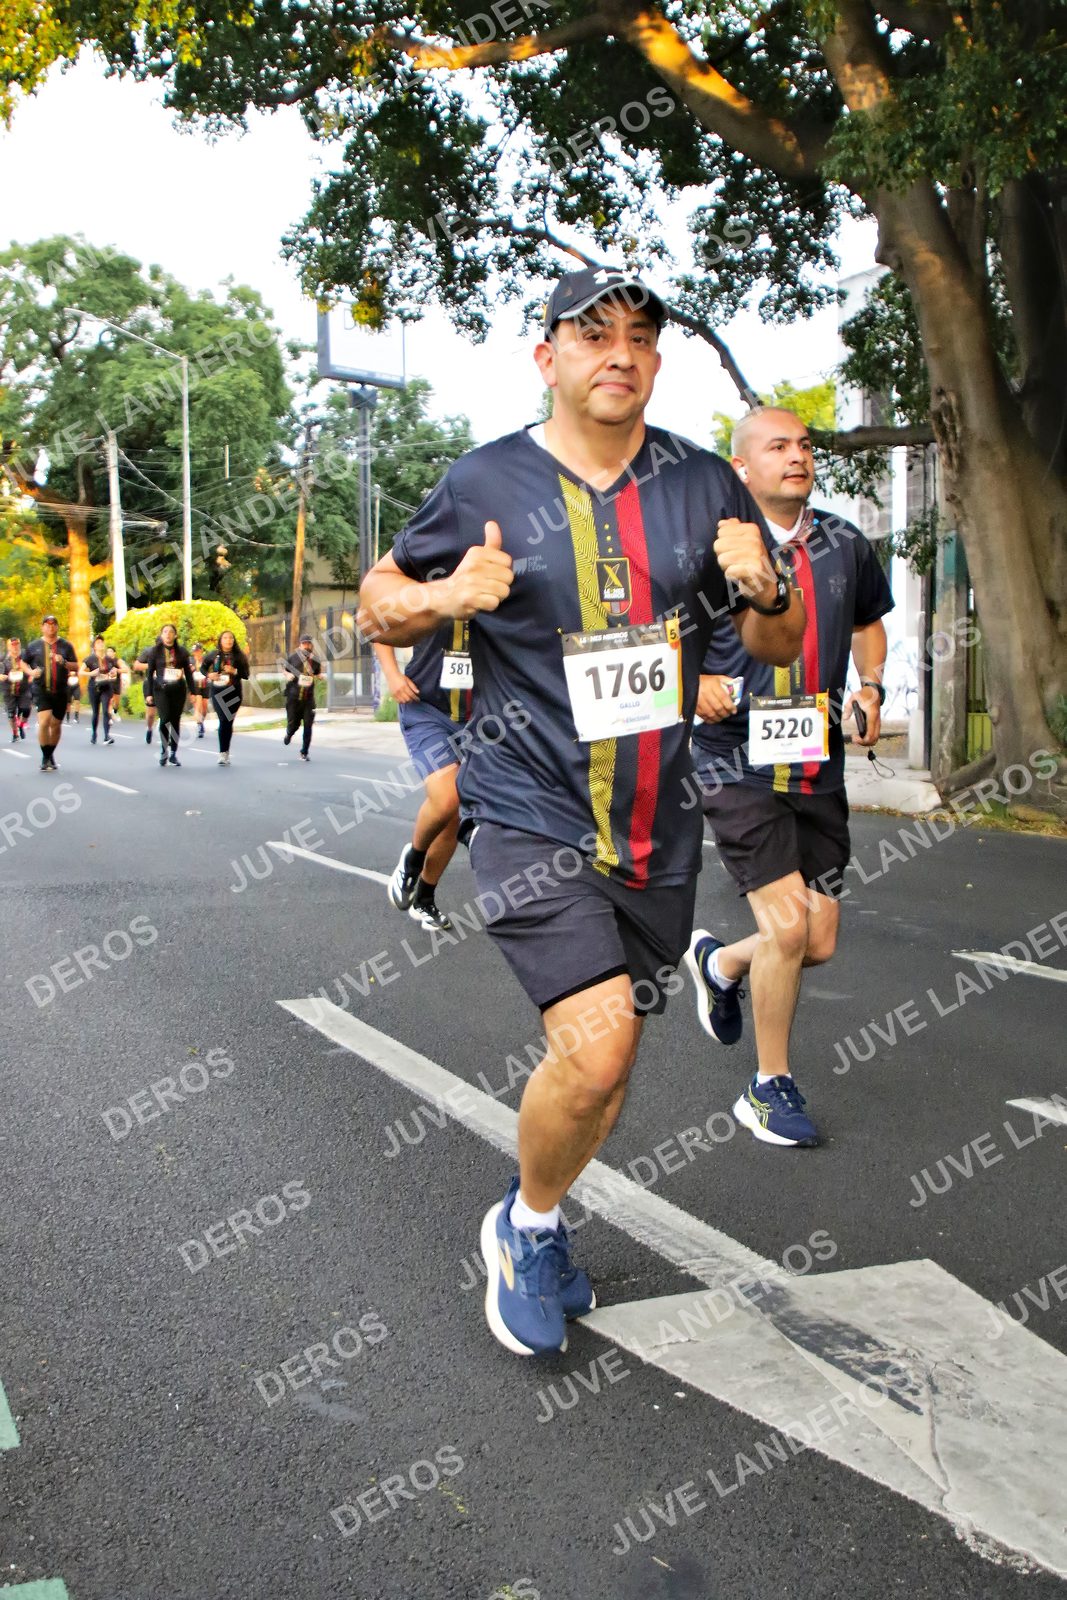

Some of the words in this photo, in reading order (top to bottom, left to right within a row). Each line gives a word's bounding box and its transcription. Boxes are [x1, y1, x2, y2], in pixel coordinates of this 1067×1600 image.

[449, 661, 471, 676] 581
[585, 656, 666, 701] 1766
[619, 700, 641, 709] GALLO
[760, 716, 813, 741] 5220
